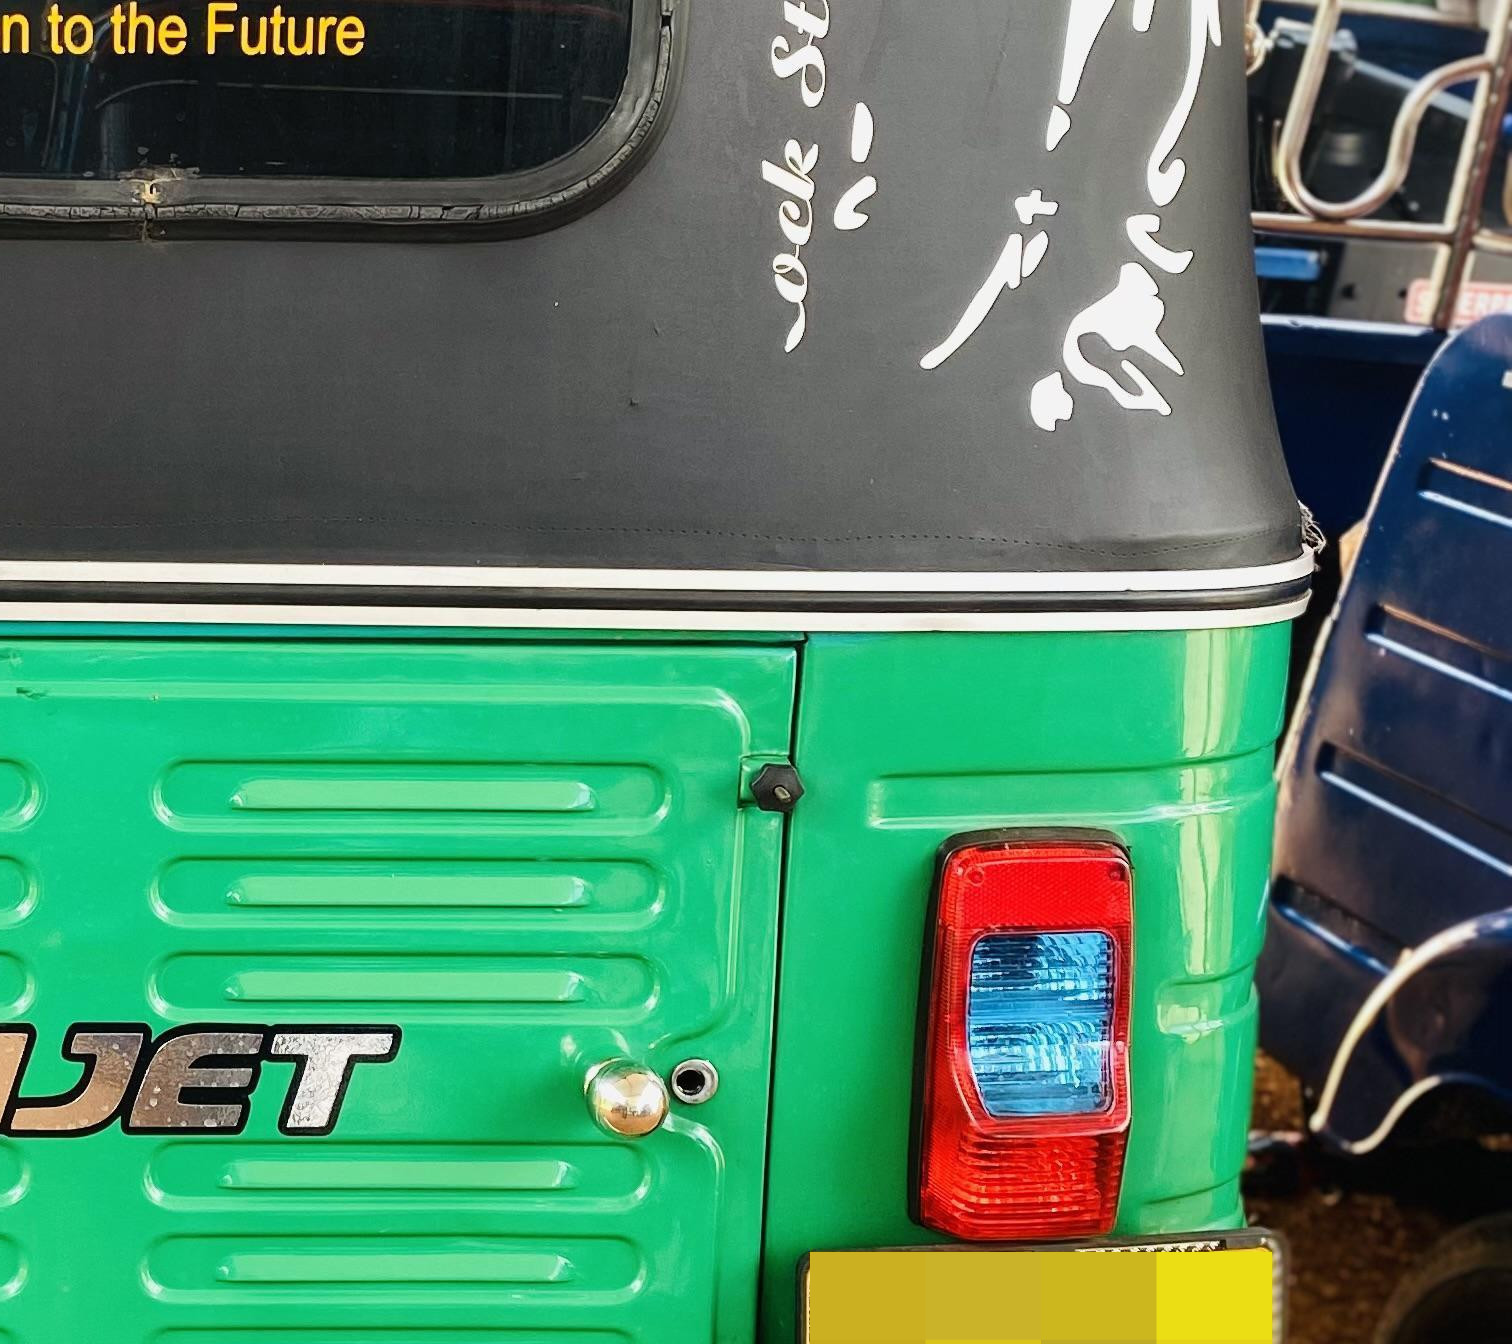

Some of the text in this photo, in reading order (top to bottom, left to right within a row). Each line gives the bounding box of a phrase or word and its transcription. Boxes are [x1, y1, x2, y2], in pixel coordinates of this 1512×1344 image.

[47, 3, 94, 55] to
[110, 1, 187, 55] the
[206, 2, 366, 56] Future
[761, 138, 819, 353] ock
